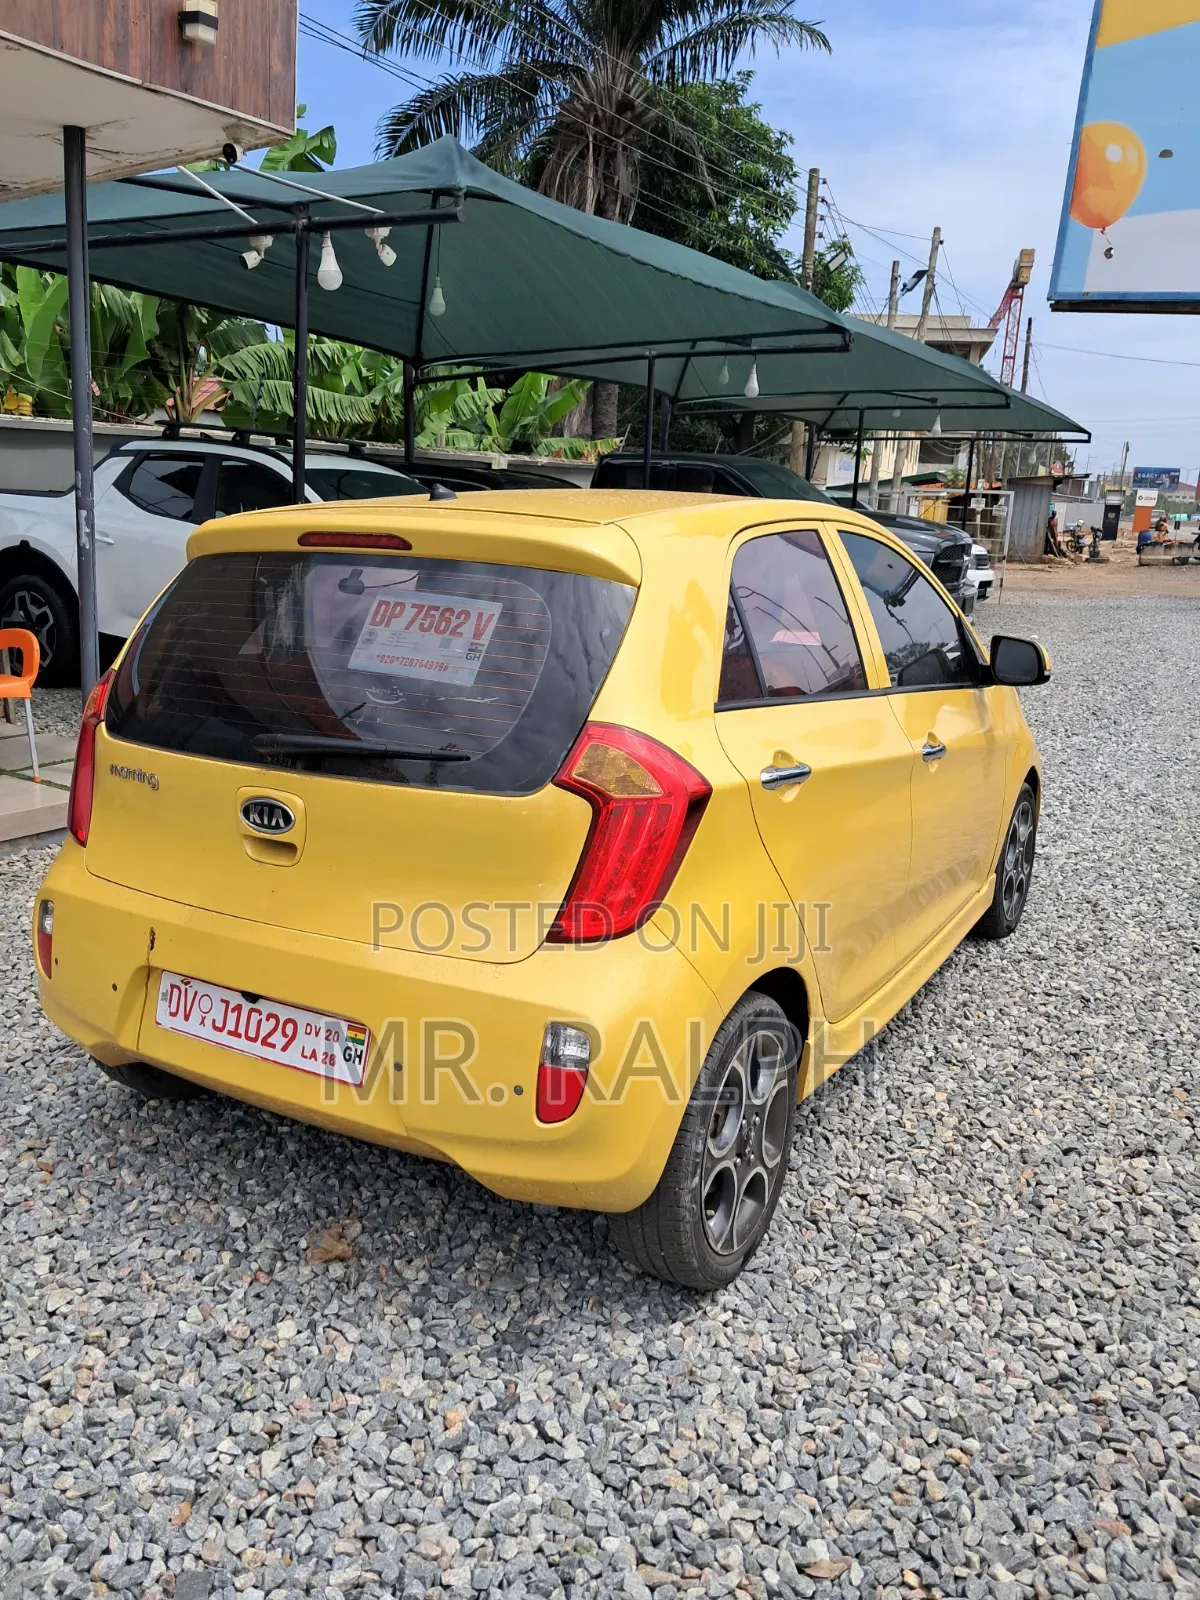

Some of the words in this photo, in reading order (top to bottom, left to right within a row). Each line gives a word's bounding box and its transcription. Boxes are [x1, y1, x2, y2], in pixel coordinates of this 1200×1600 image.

[369, 600, 406, 628] DP
[404, 603, 471, 637] 7562
[472, 612, 495, 640] V
[465, 653, 482, 662] GH
[109, 763, 160, 791] morning
[249, 804, 286, 828] KIA
[168, 983, 198, 1022] DV
[211, 998, 298, 1052] J1029
[304, 1022, 321, 1038] DV
[324, 1028, 340, 1043] 20
[300, 1045, 317, 1062] LA
[343, 1045, 363, 1066] GH
